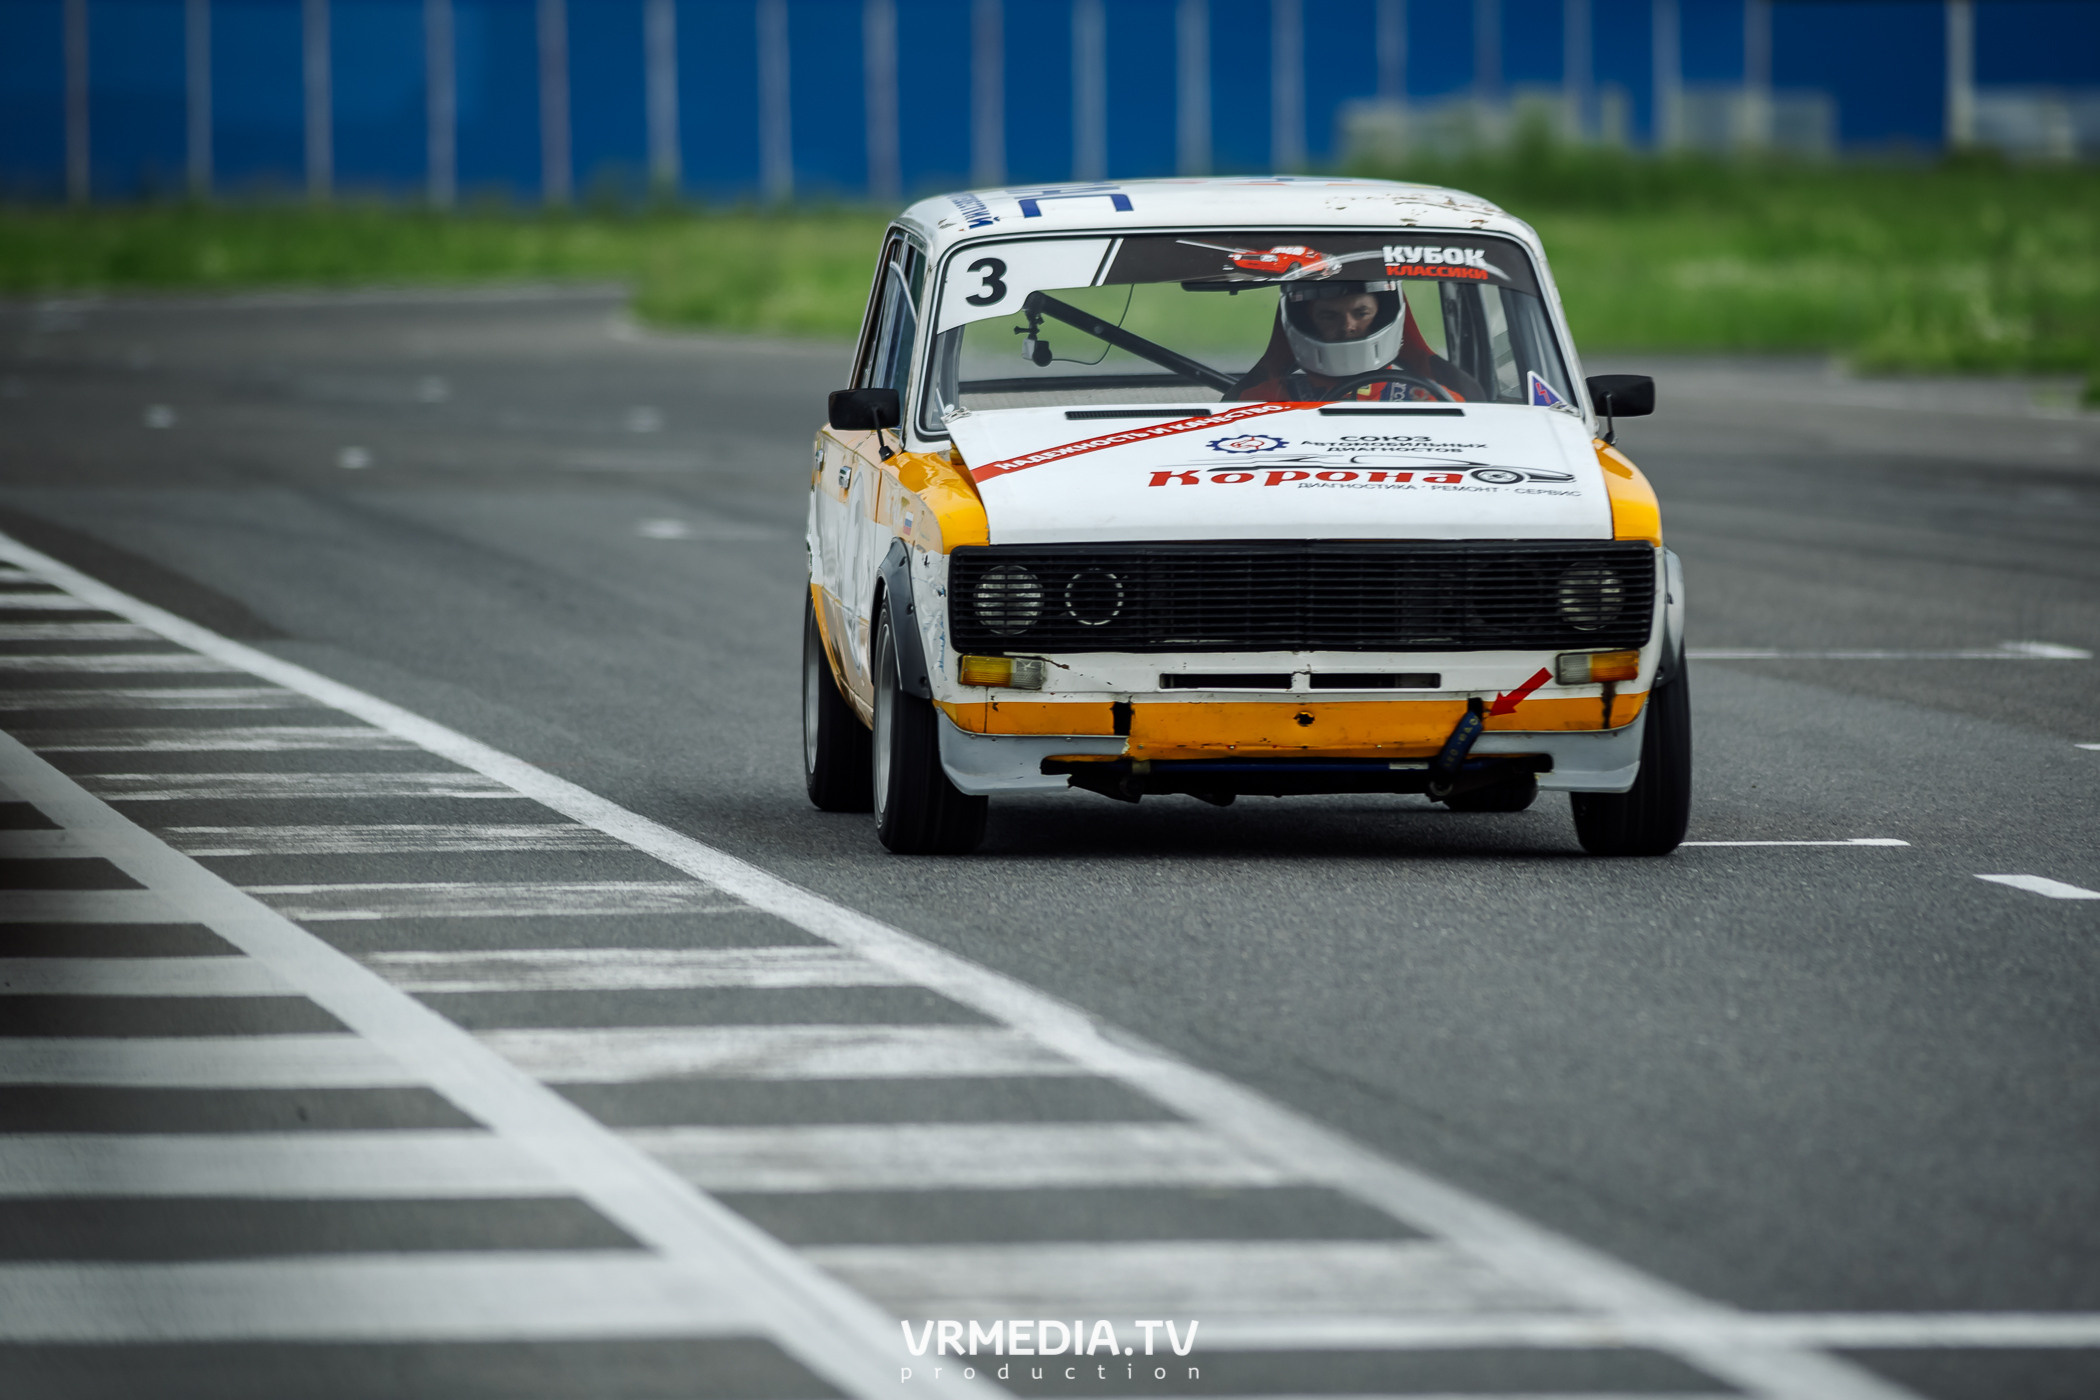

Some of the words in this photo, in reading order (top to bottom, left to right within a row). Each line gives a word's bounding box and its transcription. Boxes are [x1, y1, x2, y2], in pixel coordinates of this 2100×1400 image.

[1382, 245, 1486, 267] КУБОК
[965, 256, 1008, 307] 3
[1386, 265, 1489, 280] КЛАССИКИ
[994, 431, 1151, 471] НАДЕЖНОСТЬ
[1147, 426, 1173, 435] И
[1169, 404, 1291, 431] КАЧЕСТВО.
[1297, 482, 1418, 490] ДИАГНОСТИКА
[1431, 485, 1499, 493] РЕМОНТ
[1514, 487, 1583, 497] СЕРВИС
